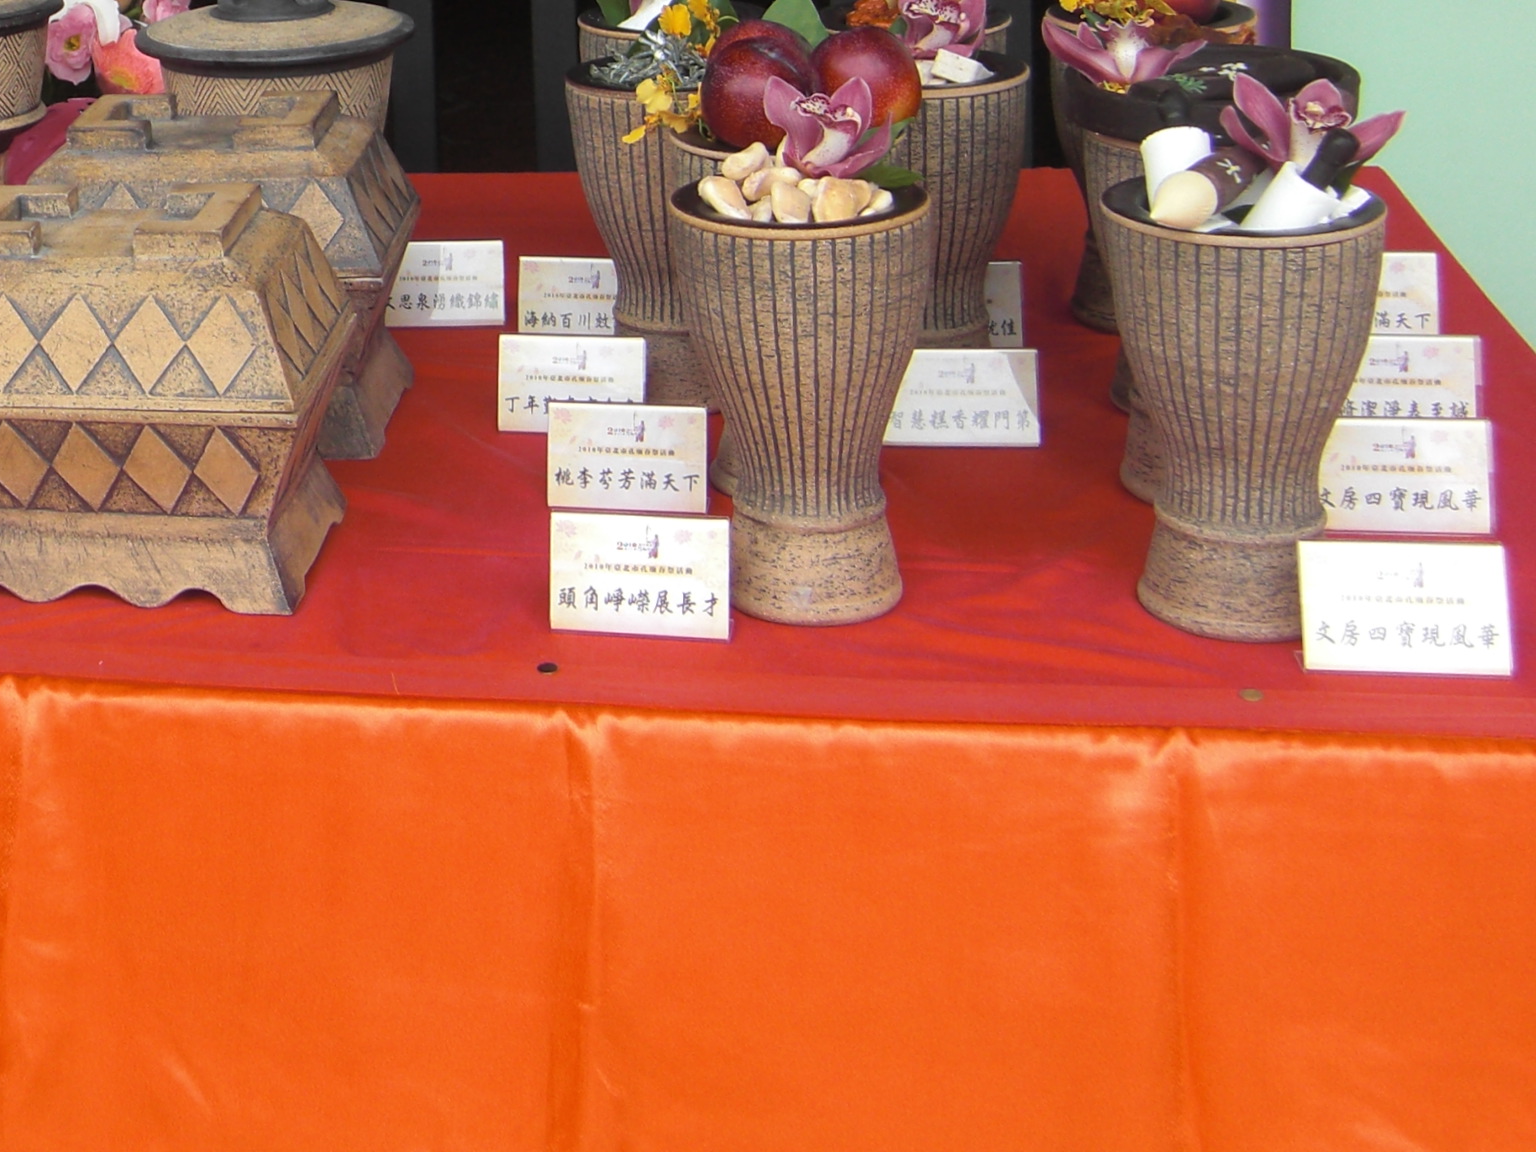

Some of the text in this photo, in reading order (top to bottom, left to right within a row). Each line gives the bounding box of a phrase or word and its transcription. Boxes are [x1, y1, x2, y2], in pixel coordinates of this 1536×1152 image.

[554, 465, 700, 494] 桃李芬芳滿天下
[558, 586, 719, 618] 頭角崢嶸展長才
